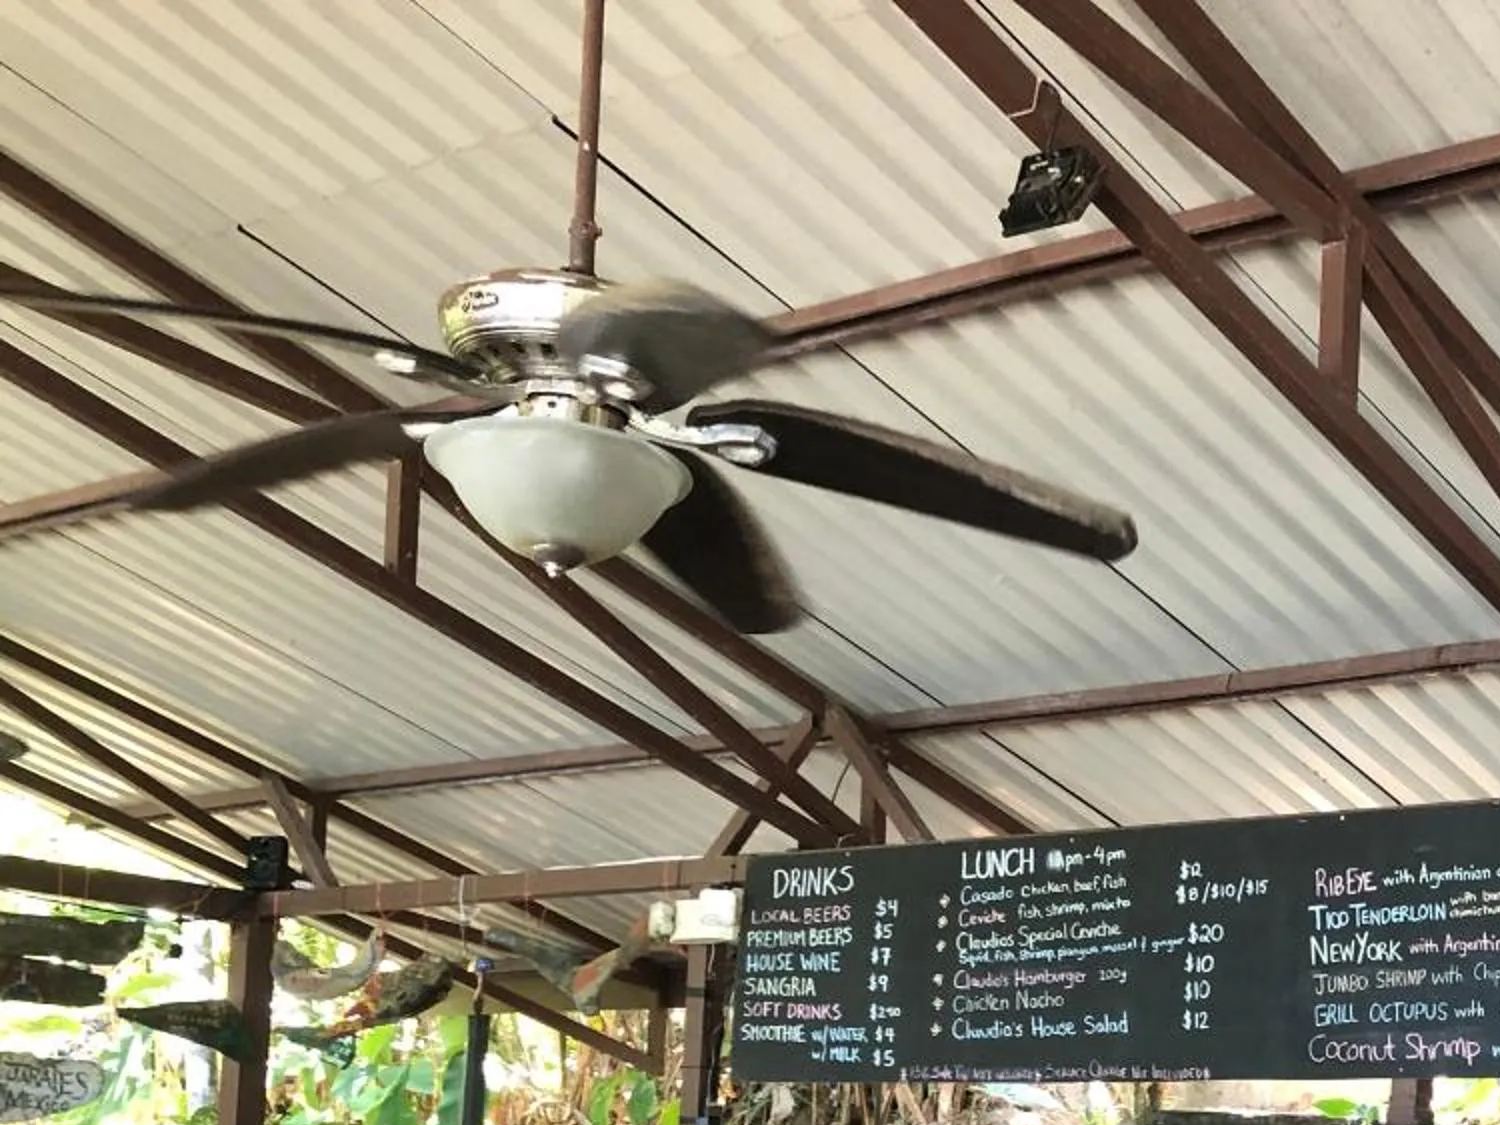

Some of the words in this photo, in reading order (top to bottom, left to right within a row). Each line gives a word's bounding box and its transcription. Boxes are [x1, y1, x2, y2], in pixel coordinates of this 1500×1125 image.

[960, 847, 1035, 879] LUNCH
[772, 866, 855, 899] DRINKS
[1383, 870, 1415, 887] with
[960, 885, 1014, 906] Casado
[751, 909, 799, 925] LOCAL
[803, 905, 852, 925] BEERS
[875, 896, 899, 918] $4
[746, 929, 806, 948] PREMIUM
[808, 926, 853, 947] BEERS
[874, 920, 894, 940] $5
[1188, 922, 1225, 944] $20
[1409, 937, 1440, 955] with
[746, 952, 794, 973] HOUSE
[800, 951, 841, 973] WINE
[871, 946, 892, 966] $7
[1184, 952, 1215, 973] $10
[743, 976, 817, 997] SANGRIA
[868, 972, 889, 992] $9
[1312, 973, 1369, 996] JUMBO
[1376, 969, 1427, 990] SHRIMP
[1431, 965, 1464, 985] with
[1015, 989, 1065, 1010] Nacho
[1184, 980, 1211, 1002] $10
[743, 1000, 781, 1018] SOFT
[786, 1002, 842, 1021] DRINKS
[1031, 1015, 1077, 1038] House
[1083, 1010, 1129, 1034] Salad
[1182, 1009, 1211, 1030] $12
[1314, 1003, 1359, 1027] GRILL
[1453, 999, 1485, 1019] with
[875, 1025, 896, 1043] $4
[873, 1048, 895, 1067] $5
[1308, 1033, 1397, 1064] Coconut
[1405, 1032, 1482, 1067] Shrimp
